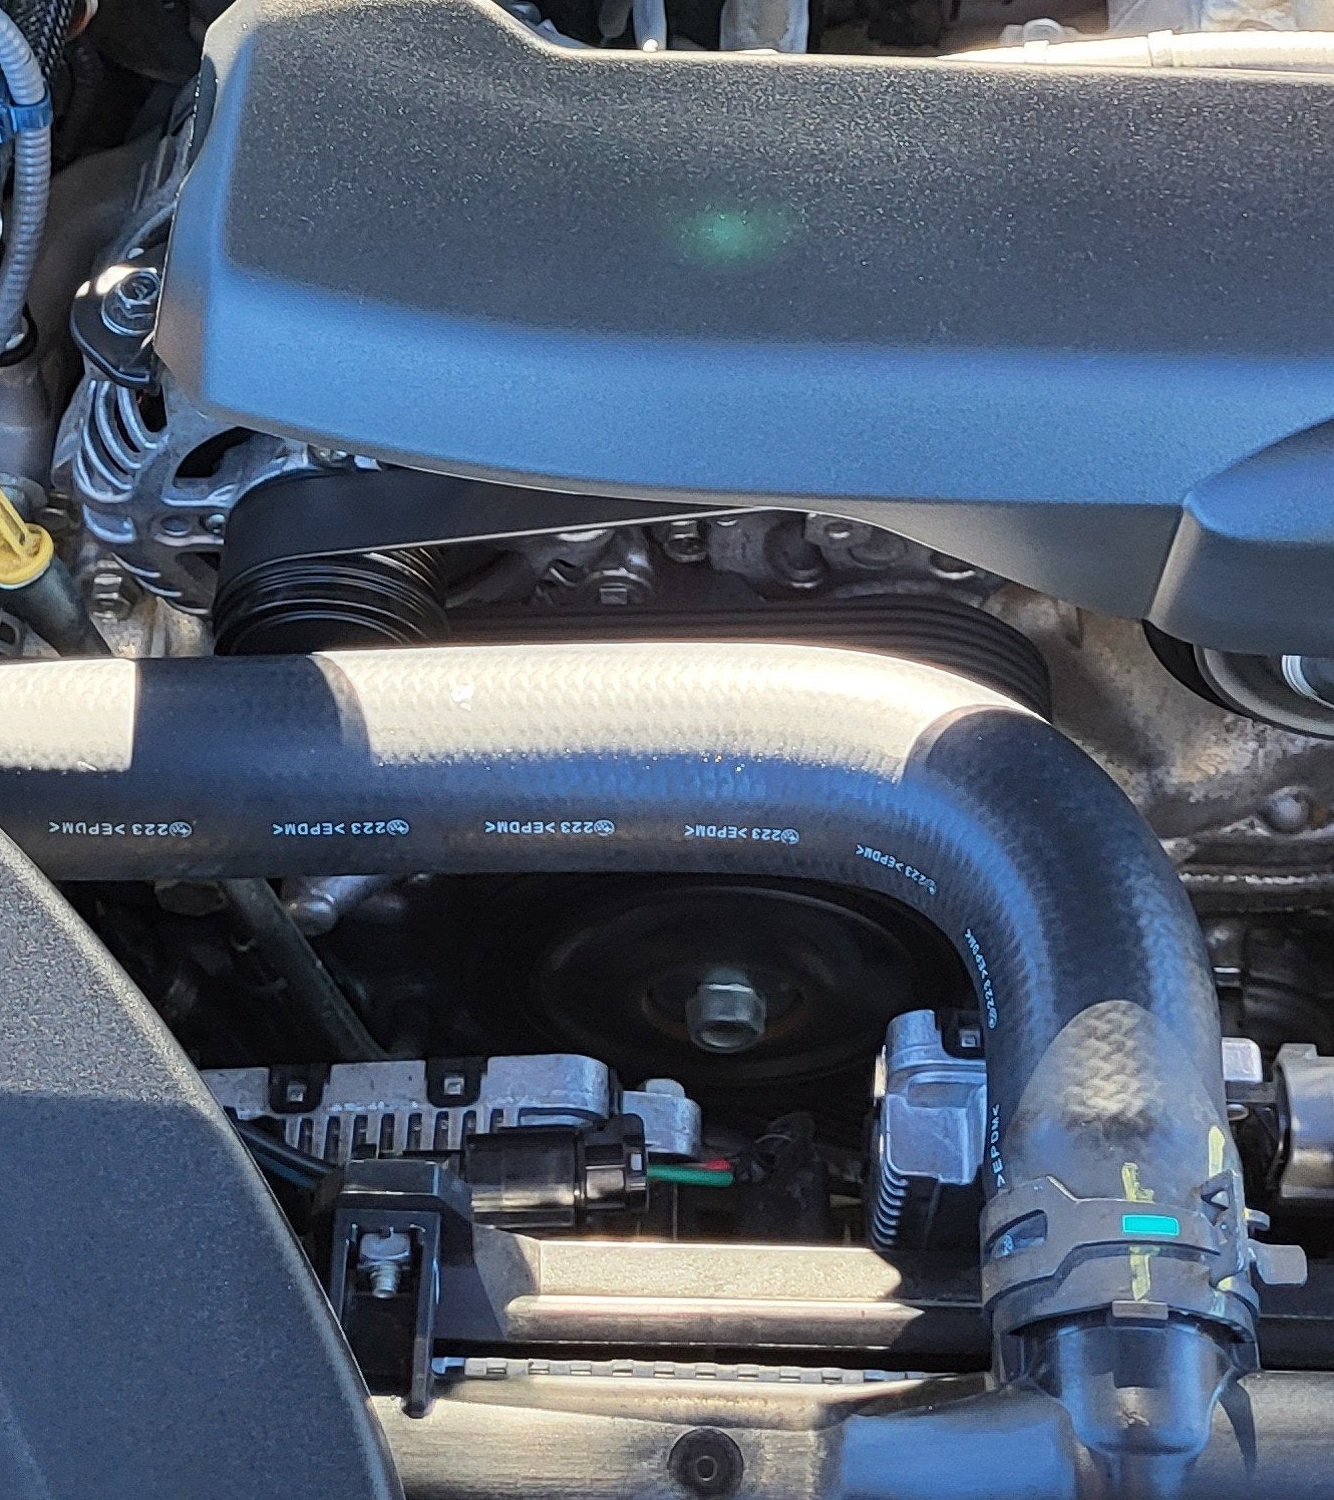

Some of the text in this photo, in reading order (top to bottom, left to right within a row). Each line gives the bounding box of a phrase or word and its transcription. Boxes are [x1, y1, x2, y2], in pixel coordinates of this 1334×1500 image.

[132, 823, 169, 836] 223
[351, 820, 386, 834] 223
[560, 820, 594, 834] 223
[751, 827, 781, 842] 223
[905, 865, 927, 886] 223
